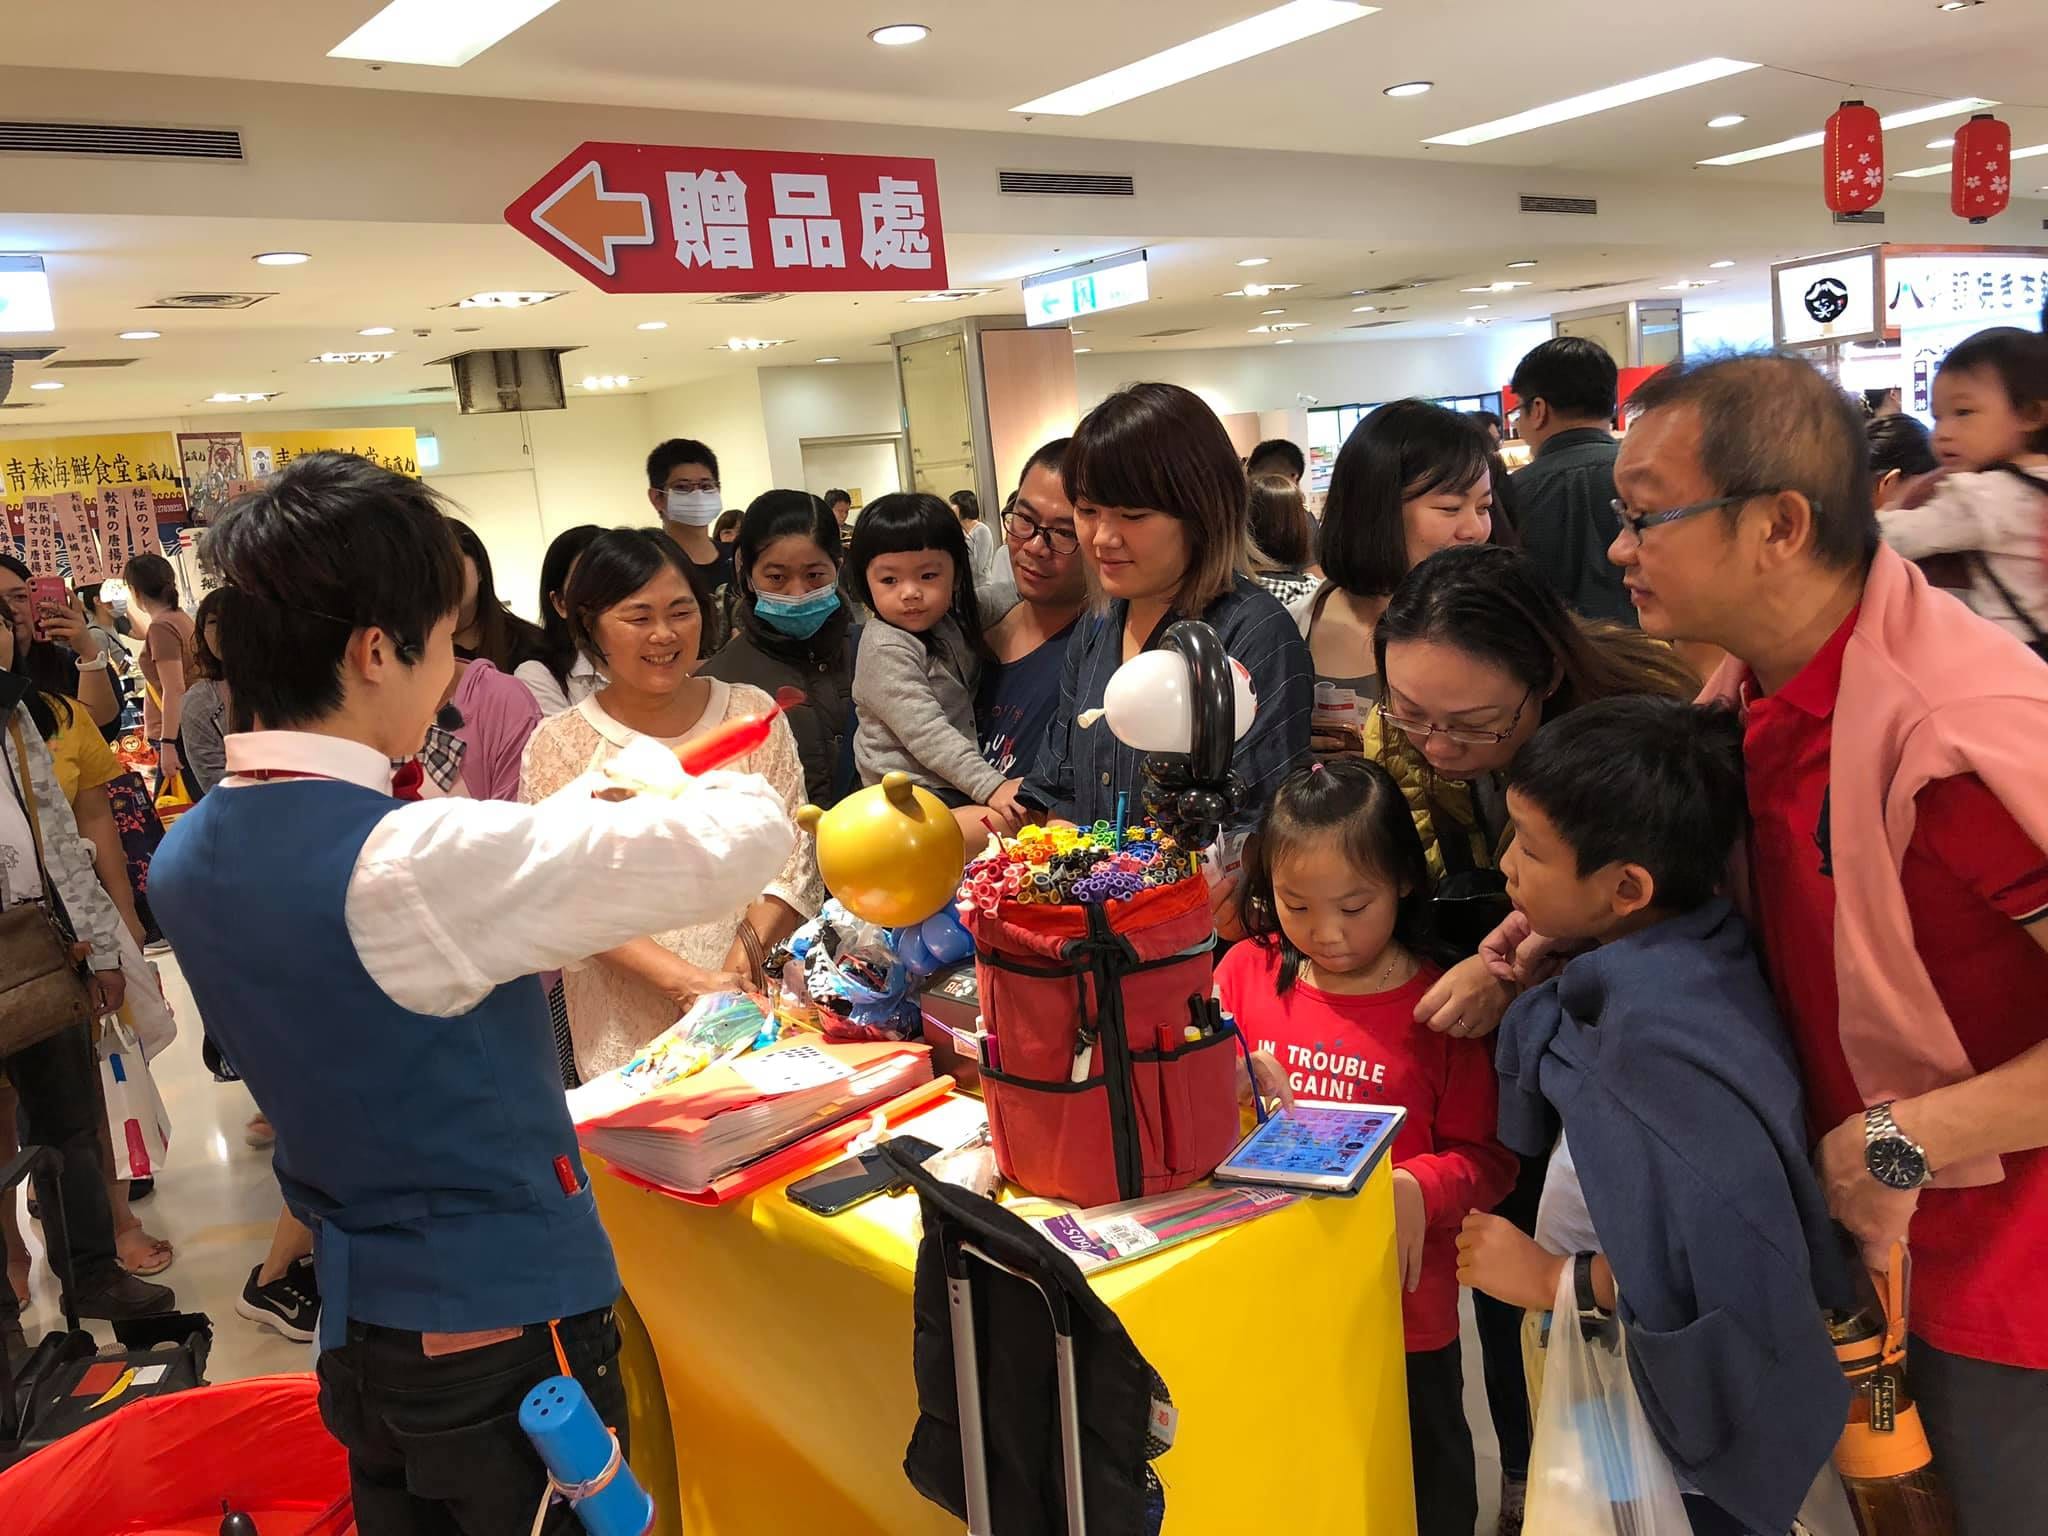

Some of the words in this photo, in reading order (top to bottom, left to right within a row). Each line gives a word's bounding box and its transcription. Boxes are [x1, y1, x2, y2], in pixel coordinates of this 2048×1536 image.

[664, 168, 932, 271] 贈品處
[7, 453, 133, 492] 青森海鮮食堂
[26, 502, 42, 577] 明太マヨ唐揚
[39, 502, 52, 577] 圧倒的な旨さ
[104, 491, 123, 575] 軟骨の唐揚げ
[1287, 1044, 1386, 1084] TROUBLE
[1289, 1071, 1354, 1101] GAIN!
